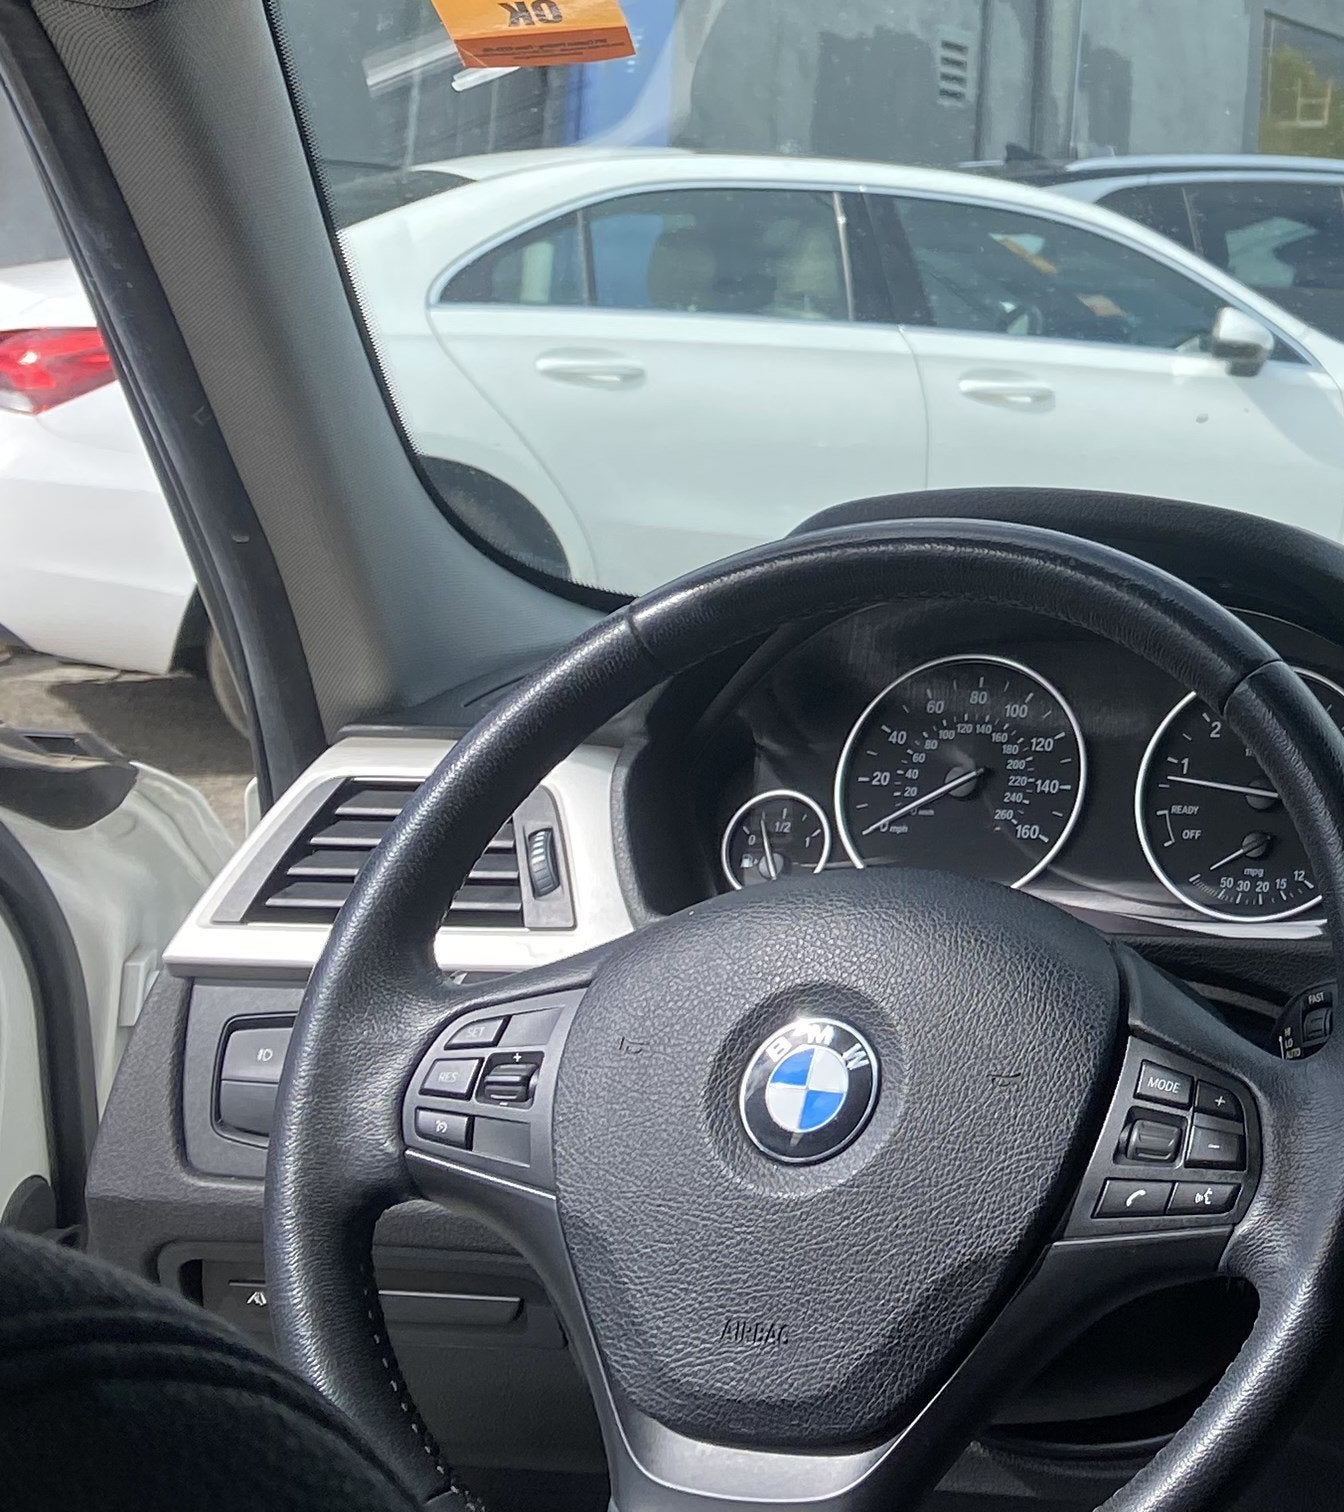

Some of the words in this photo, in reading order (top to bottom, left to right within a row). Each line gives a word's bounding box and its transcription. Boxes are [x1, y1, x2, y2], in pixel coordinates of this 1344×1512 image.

[970, 690, 988, 705] 80
[927, 700, 944, 714] 60
[1004, 703, 1029, 718] 100
[938, 729, 955, 740] 100
[957, 723, 973, 734] 120
[975, 723, 992, 735] 140
[1210, 723, 1220, 738] 2
[888, 730, 908, 745] 40
[991, 732, 1008, 743] 160
[925, 739, 938, 750] 80
[1002, 743, 1019, 755] 180
[1030, 737, 1054, 752] 120
[912, 752, 926, 764] 60
[1006, 759, 1026, 770] 200
[1181, 758, 1189, 773] 1
[872, 772, 891, 786] 20
[905, 768, 919, 780] 40
[1008, 775, 1028, 787] 220
[1034, 780, 1059, 794] 140
[904, 785, 918, 797] 20
[1003, 792, 1024, 804] 240
[994, 809, 1014, 821] 260
[1171, 804, 1199, 816] READY
[774, 820, 791, 833] 1/2
[1015, 825, 1040, 840] 160
[748, 834, 756, 845] 0
[1182, 829, 1202, 840] OFF
[805, 836, 811, 847] 1
[1244, 867, 1264, 878] mpg
[1221, 877, 1234, 889] 50
[1236, 881, 1250, 892] 30
[1256, 881, 1269, 892] 20
[1275, 878, 1287, 890] 15
[1293, 870, 1306, 881] 12
[1308, 992, 1324, 1005] FAST
[465, 1026, 485, 1037] SET
[765, 1022, 870, 1071] BMW
[1285, 1038, 1293, 1049] LO
[438, 1071, 459, 1083] RES
[1147, 1076, 1181, 1094] MODE
